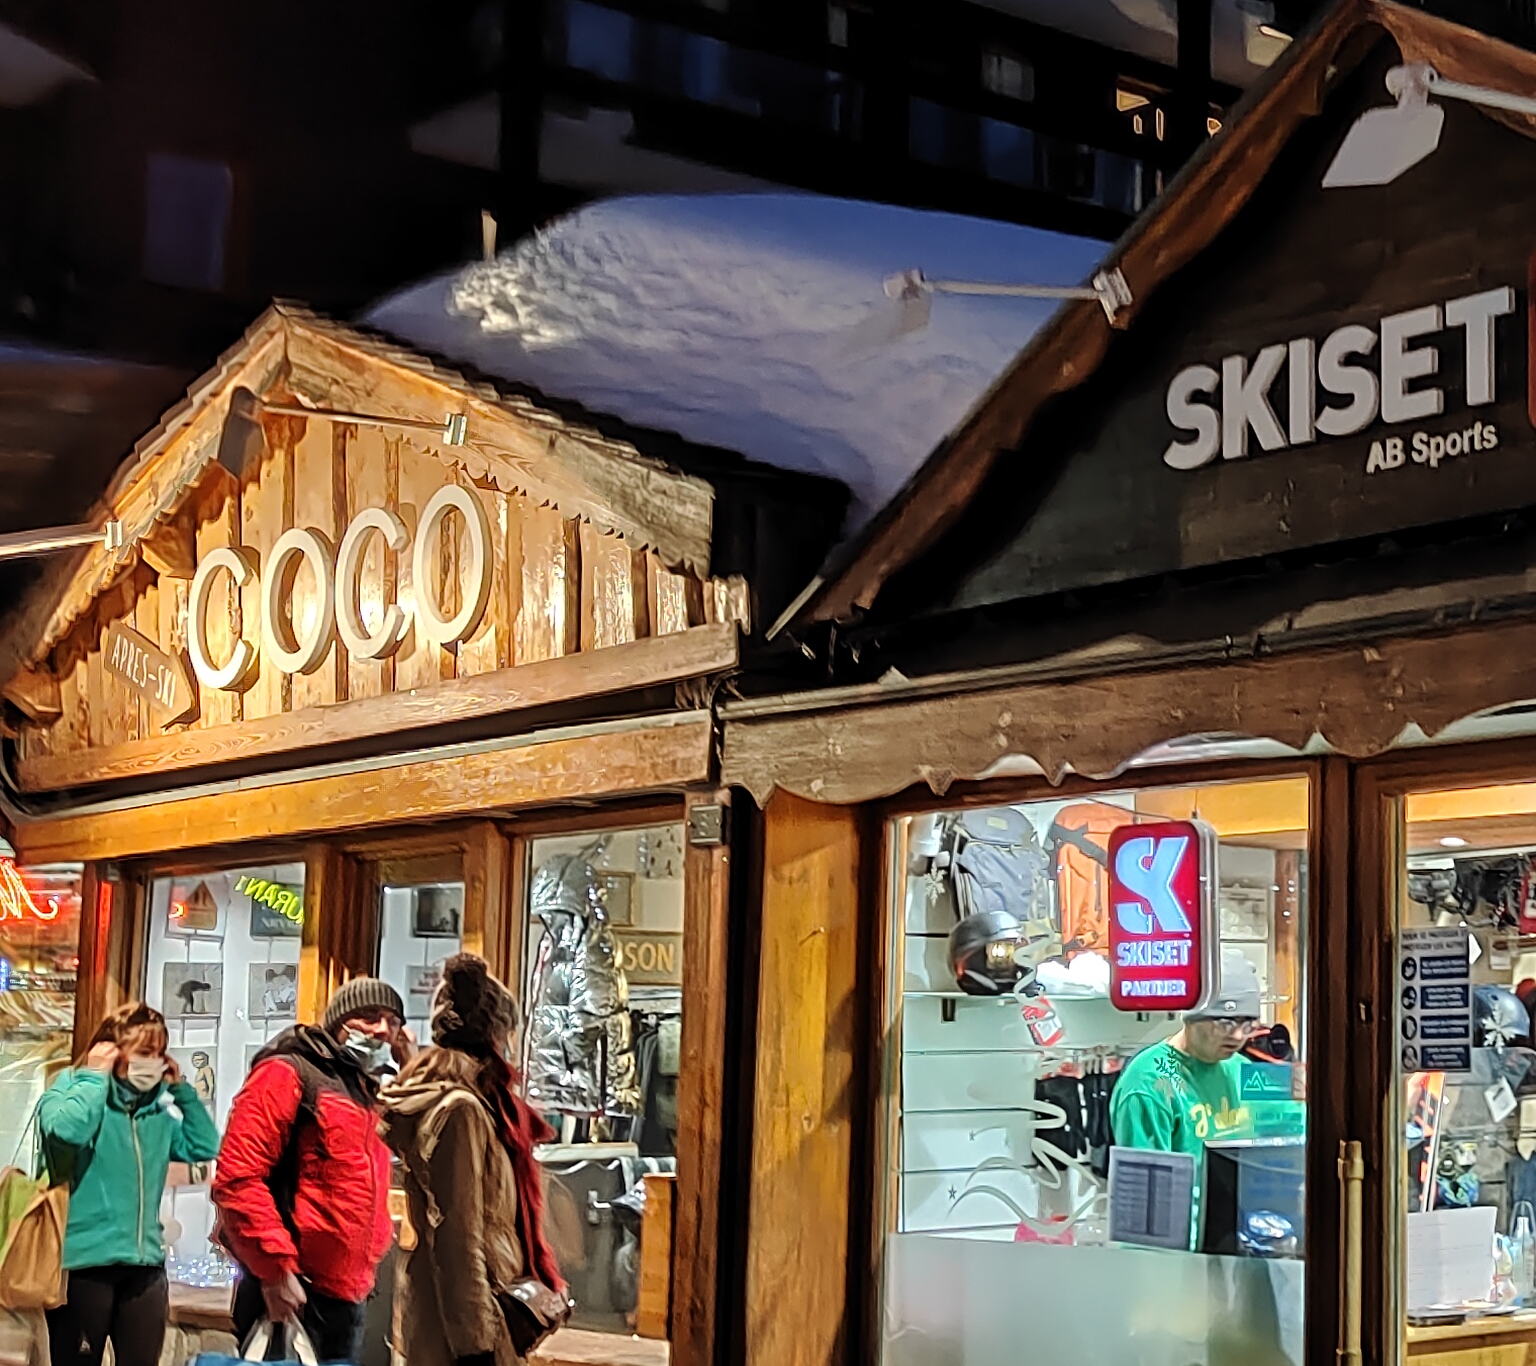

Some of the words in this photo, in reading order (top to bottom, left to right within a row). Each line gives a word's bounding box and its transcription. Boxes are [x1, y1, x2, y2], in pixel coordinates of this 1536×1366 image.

[1163, 285, 1516, 471] SKISET
[1365, 436, 1406, 474] AB
[1411, 420, 1499, 468] Sports
[187, 483, 494, 690] COCO
[1116, 939, 1193, 967] SKISET
